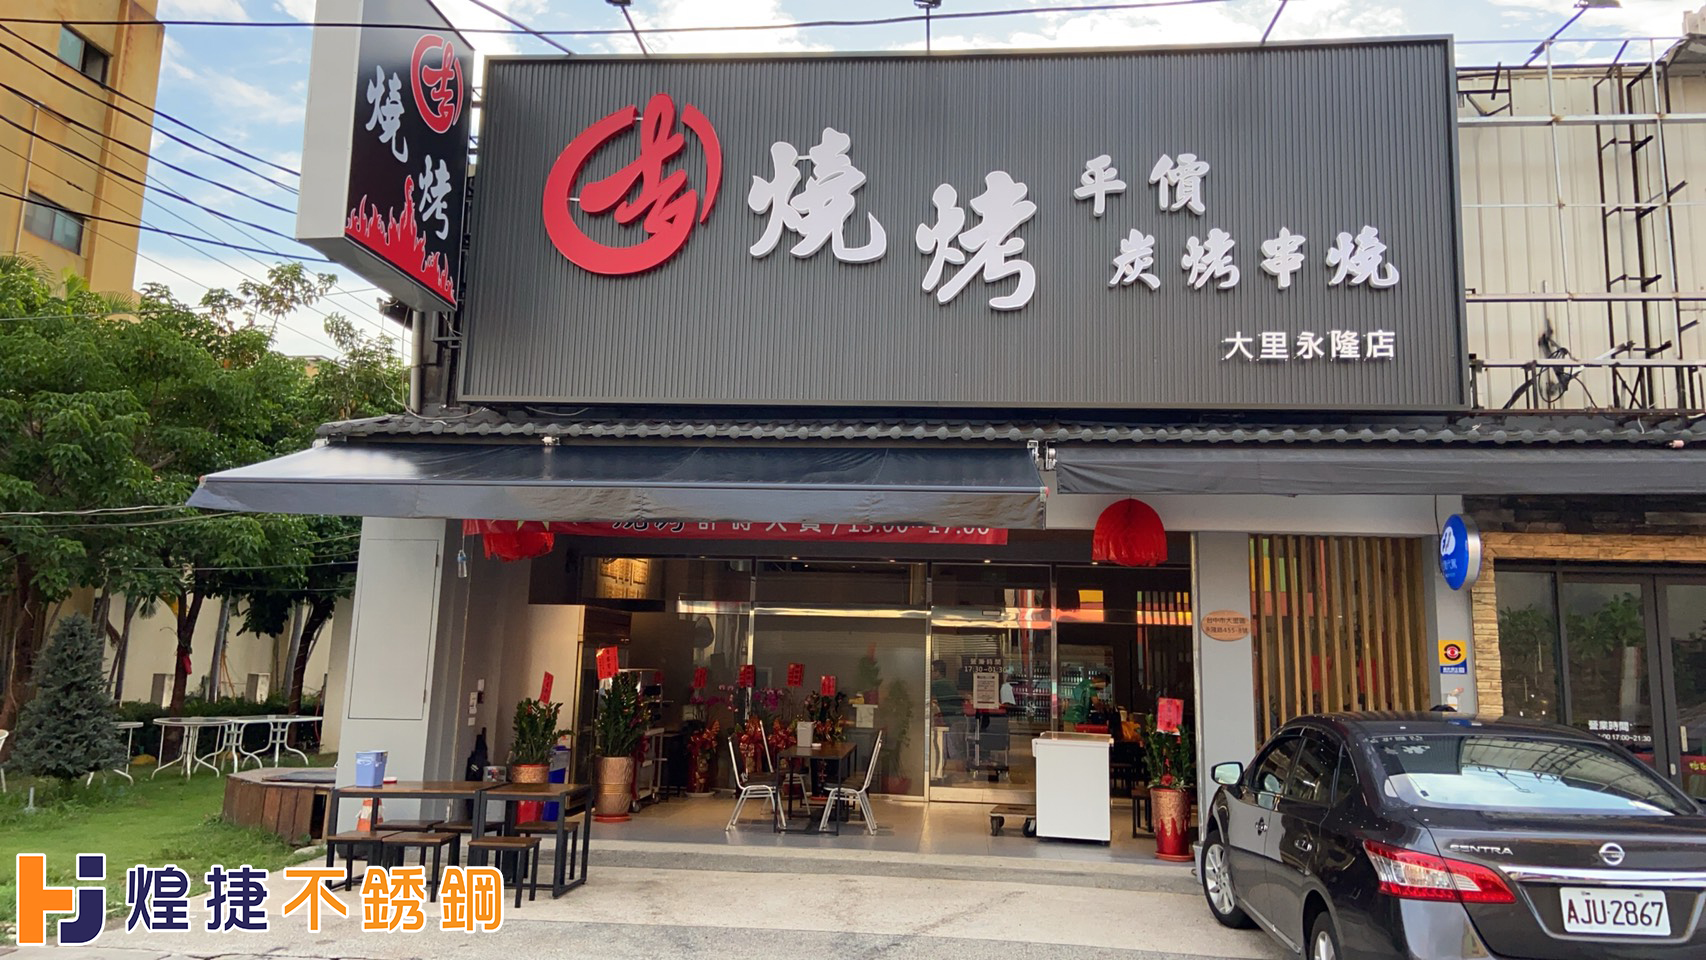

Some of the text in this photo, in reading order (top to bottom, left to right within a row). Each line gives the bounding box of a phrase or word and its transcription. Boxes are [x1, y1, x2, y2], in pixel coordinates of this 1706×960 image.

[366, 64, 452, 240] 燒烤
[1074, 153, 1210, 217] 平價
[748, 127, 1037, 311] 燒烤
[1108, 225, 1400, 291] 炭烤串燒
[1223, 330, 1396, 361] 大里永隆店
[1588, 719, 1630, 732] 營業時間
[1449, 844, 1514, 856] SENTRA
